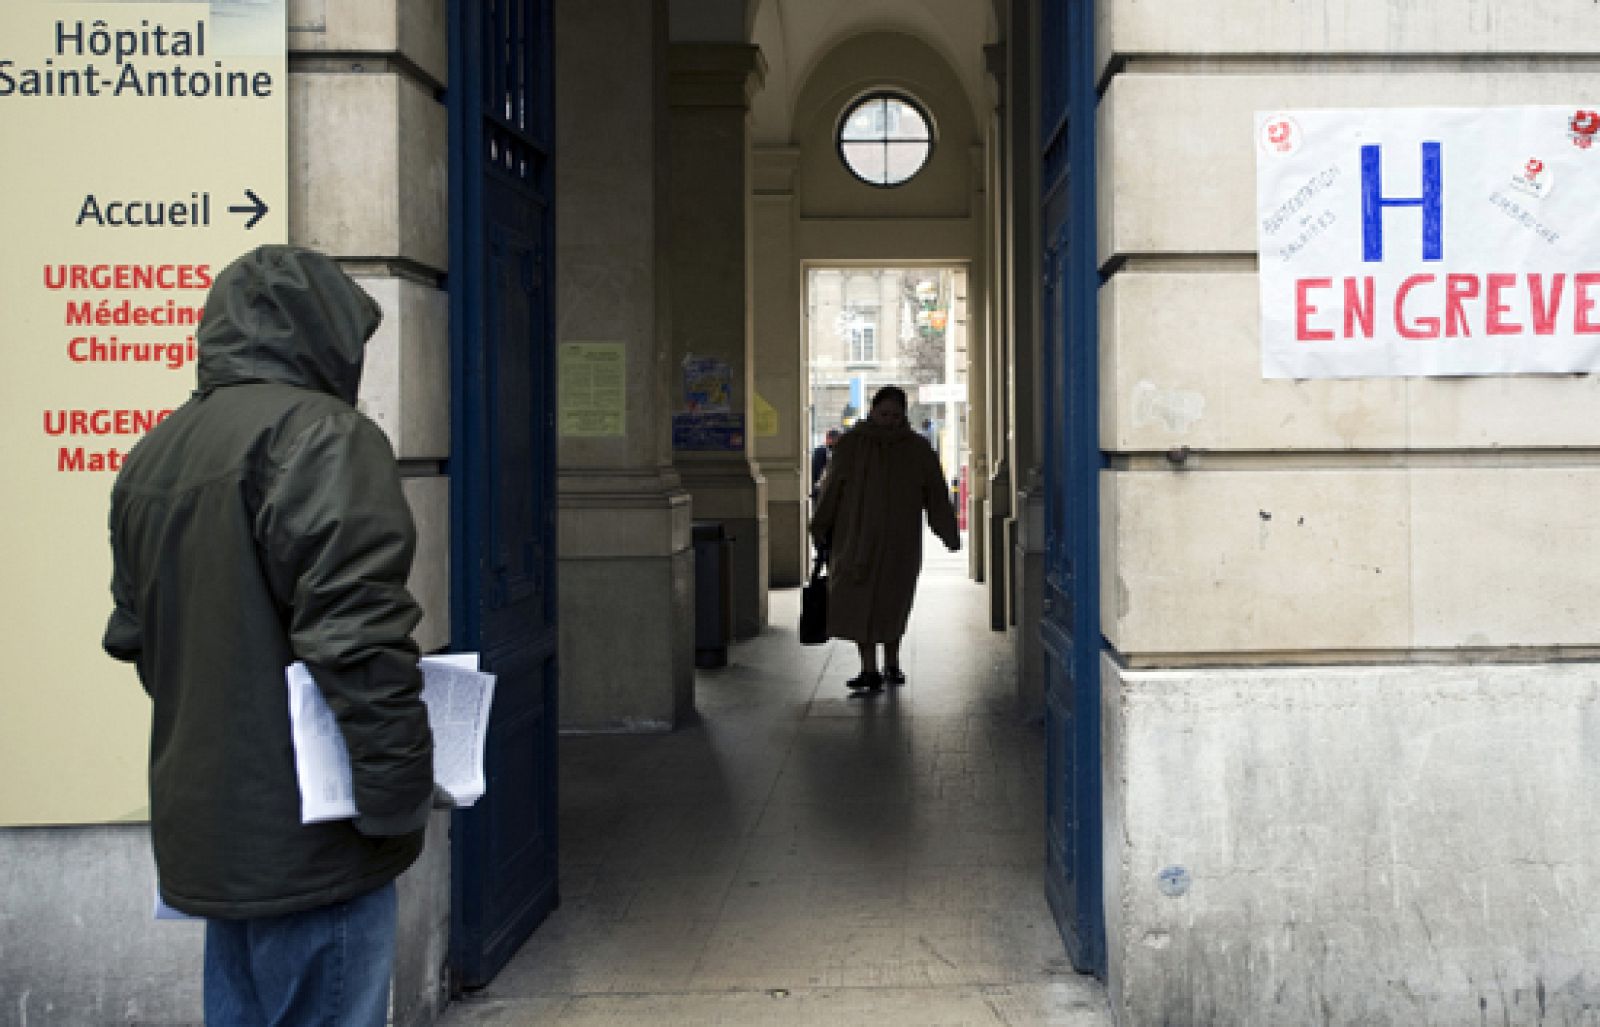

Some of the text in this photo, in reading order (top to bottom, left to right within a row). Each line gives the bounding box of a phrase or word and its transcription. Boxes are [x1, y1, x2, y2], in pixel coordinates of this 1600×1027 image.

[55, 20, 204, 64] Hôpital
[0, 59, 271, 96] Saint-Antoine
[76, 192, 210, 227] Accueil
[1360, 141, 1443, 262] H
[44, 264, 212, 289] URGENCES
[1296, 273, 1600, 341] EN GREVE
[67, 335, 198, 370] Chirurgi
[58, 447, 128, 472] Mat
